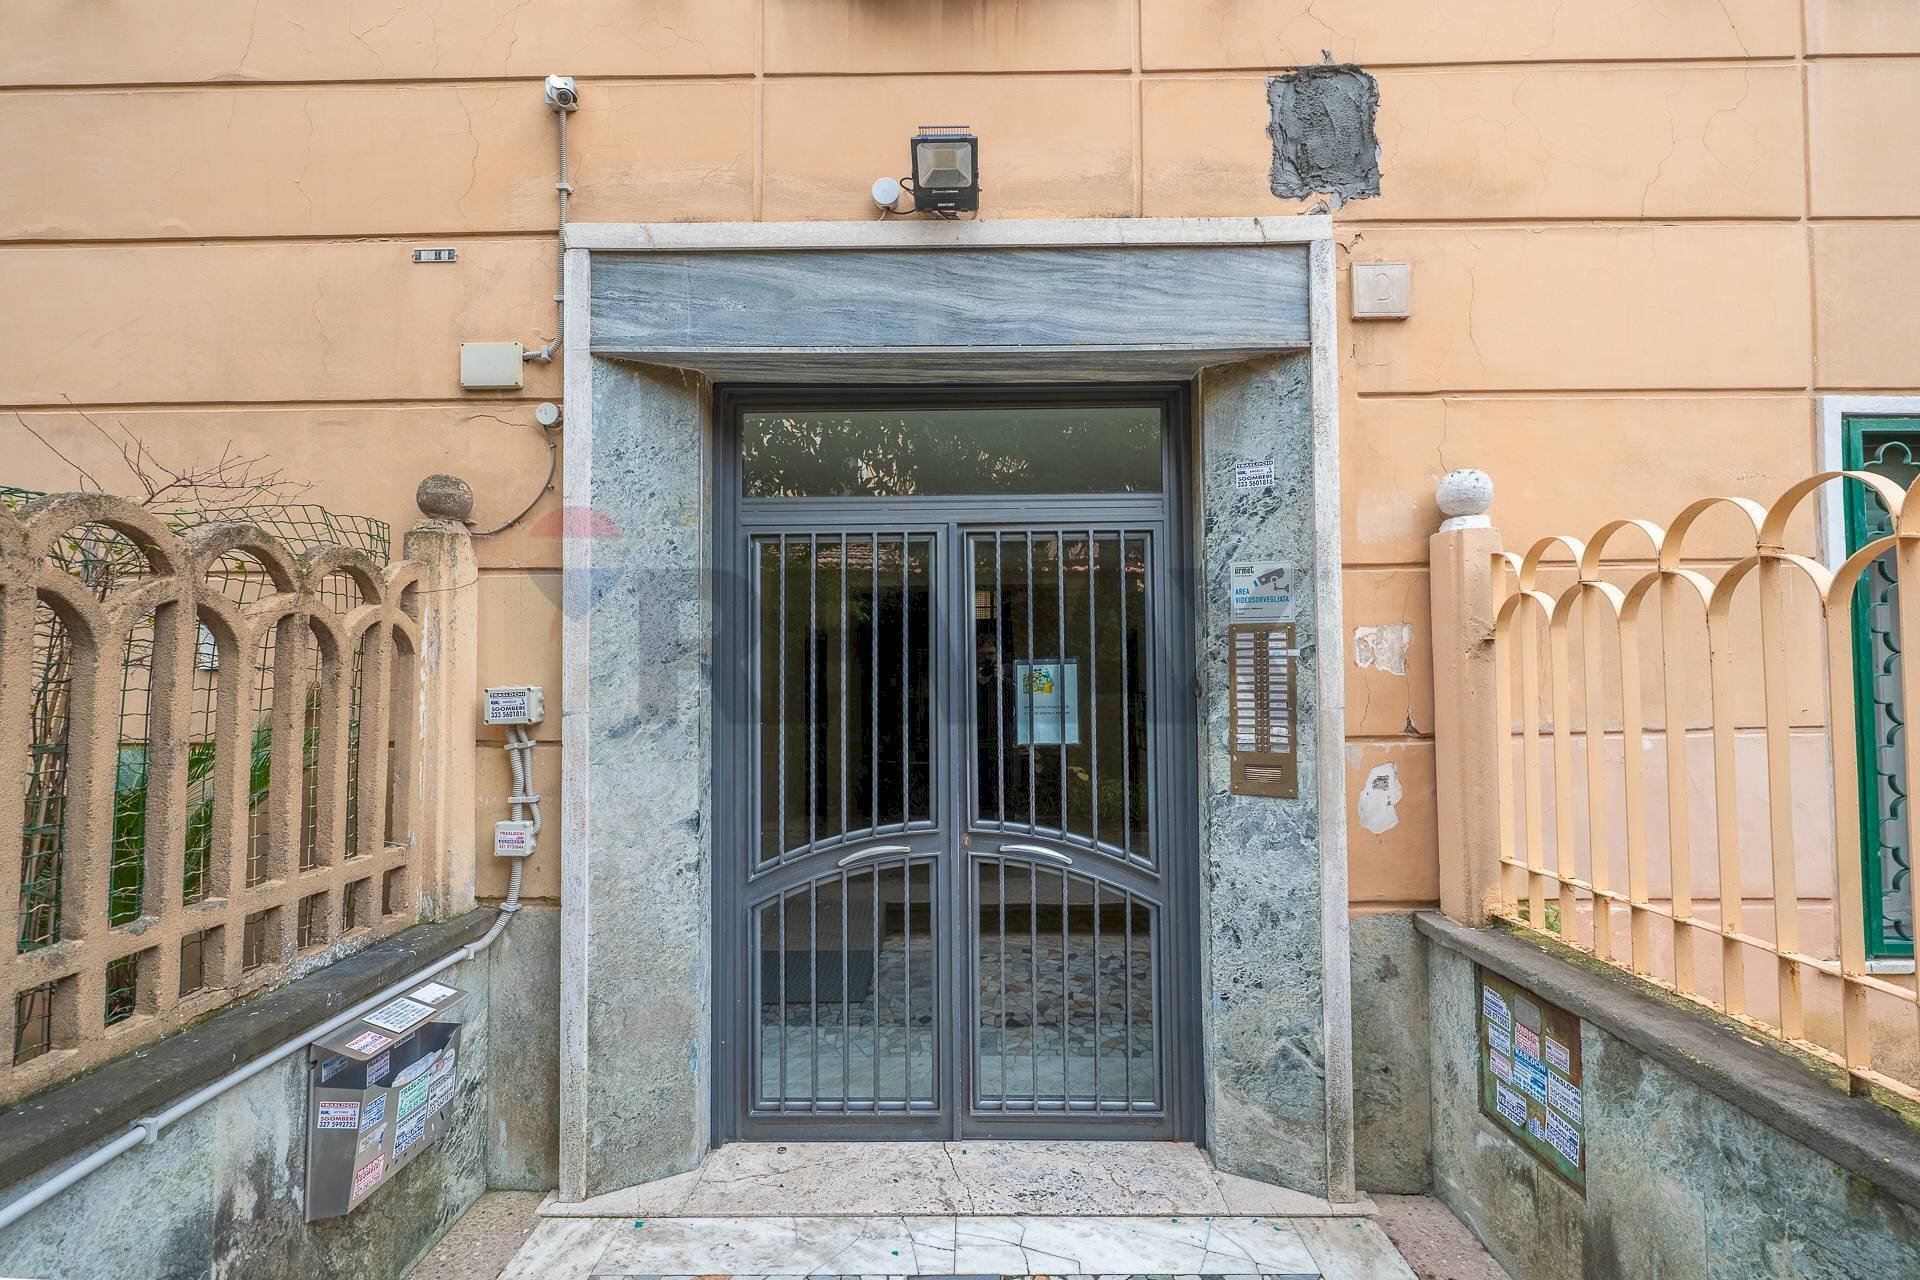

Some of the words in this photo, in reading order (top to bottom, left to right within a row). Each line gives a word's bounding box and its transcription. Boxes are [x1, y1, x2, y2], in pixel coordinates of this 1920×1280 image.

[1235, 596, 1290, 604] VIDEOSORVEGLIATA
[1549, 1072, 1581, 1098] TRASLOCHI
[1550, 1086, 1581, 1111] SGOMBERI
[1548, 1109, 1579, 1140] TRASLOCHI
